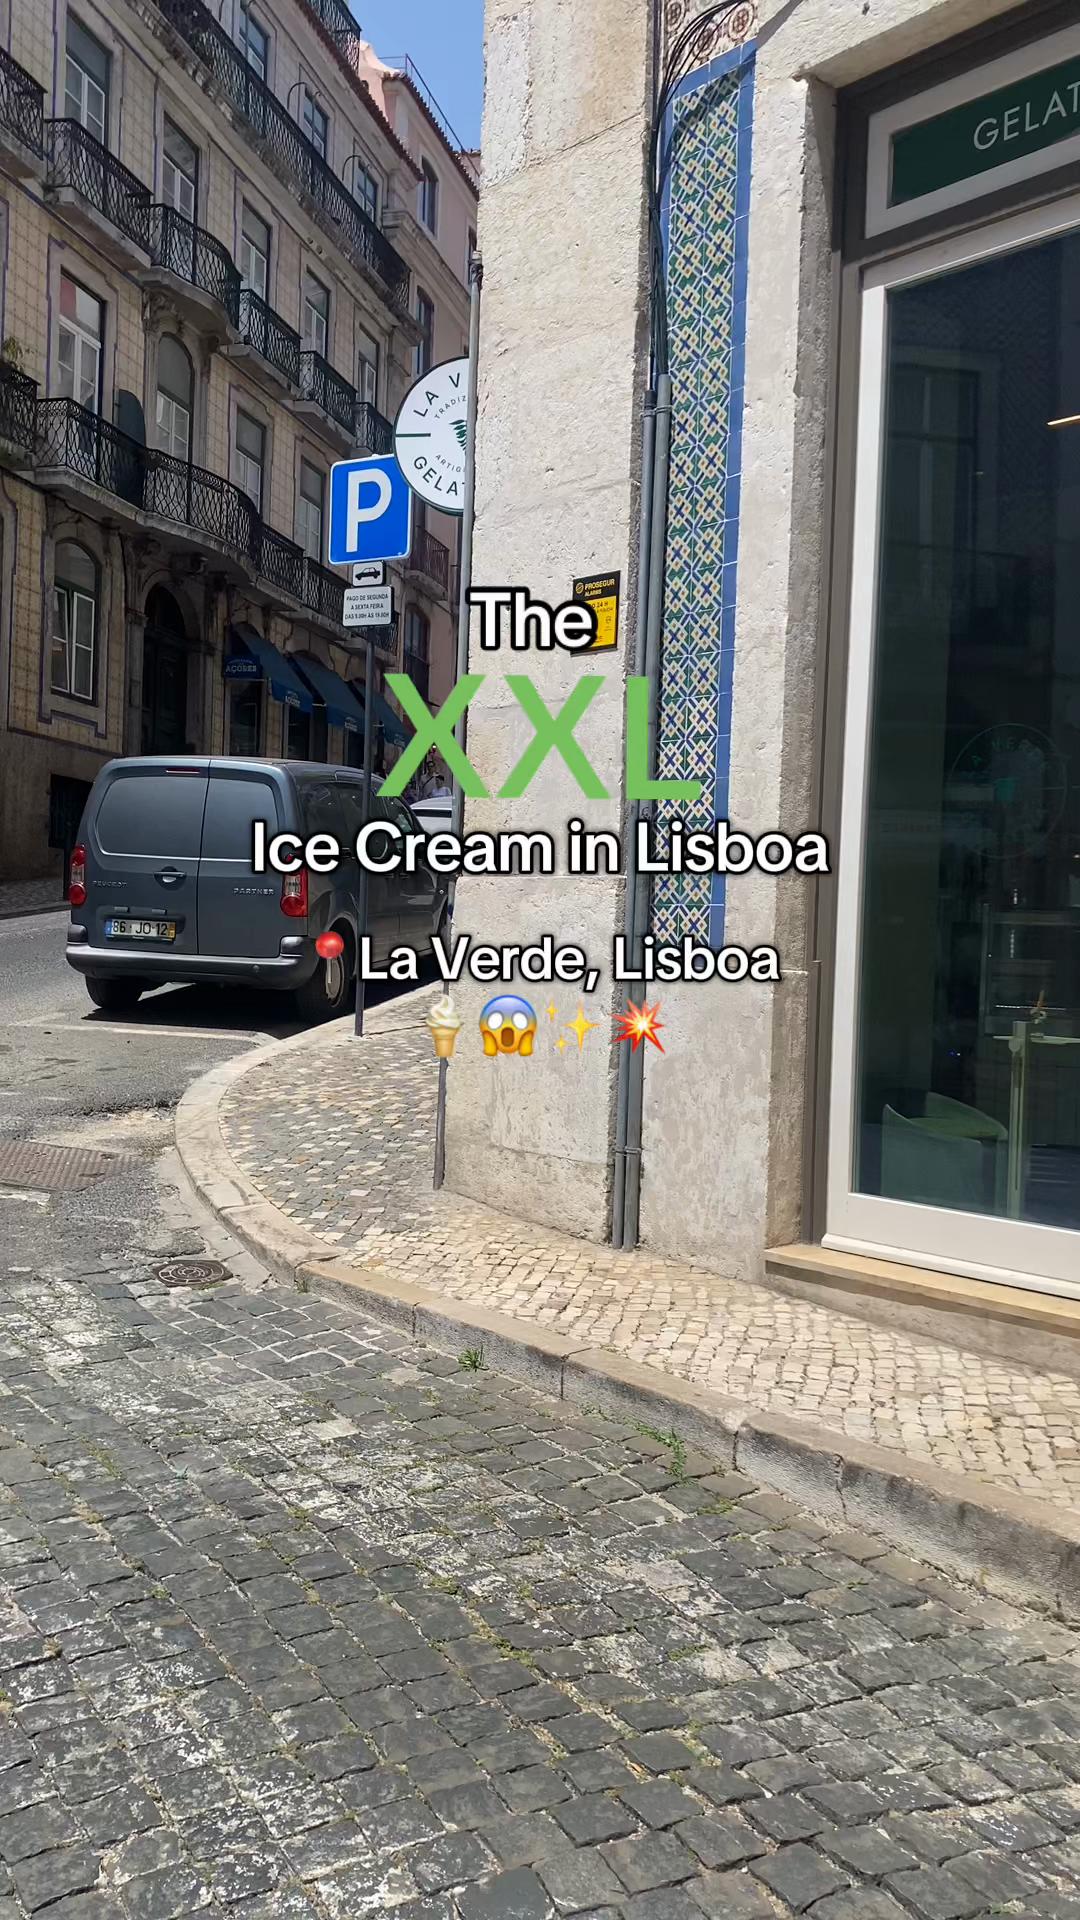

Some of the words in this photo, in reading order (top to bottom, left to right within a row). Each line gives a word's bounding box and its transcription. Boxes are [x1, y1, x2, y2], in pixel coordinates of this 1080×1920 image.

[973, 81, 1080, 150] GELAT
[413, 390, 439, 417] LA
[413, 456, 465, 496] GELA
[435, 454, 465, 473] ARTIG
[346, 468, 392, 553] P
[584, 578, 615, 591] PROSEGUR
[233, 886, 275, 895] PARTNER
